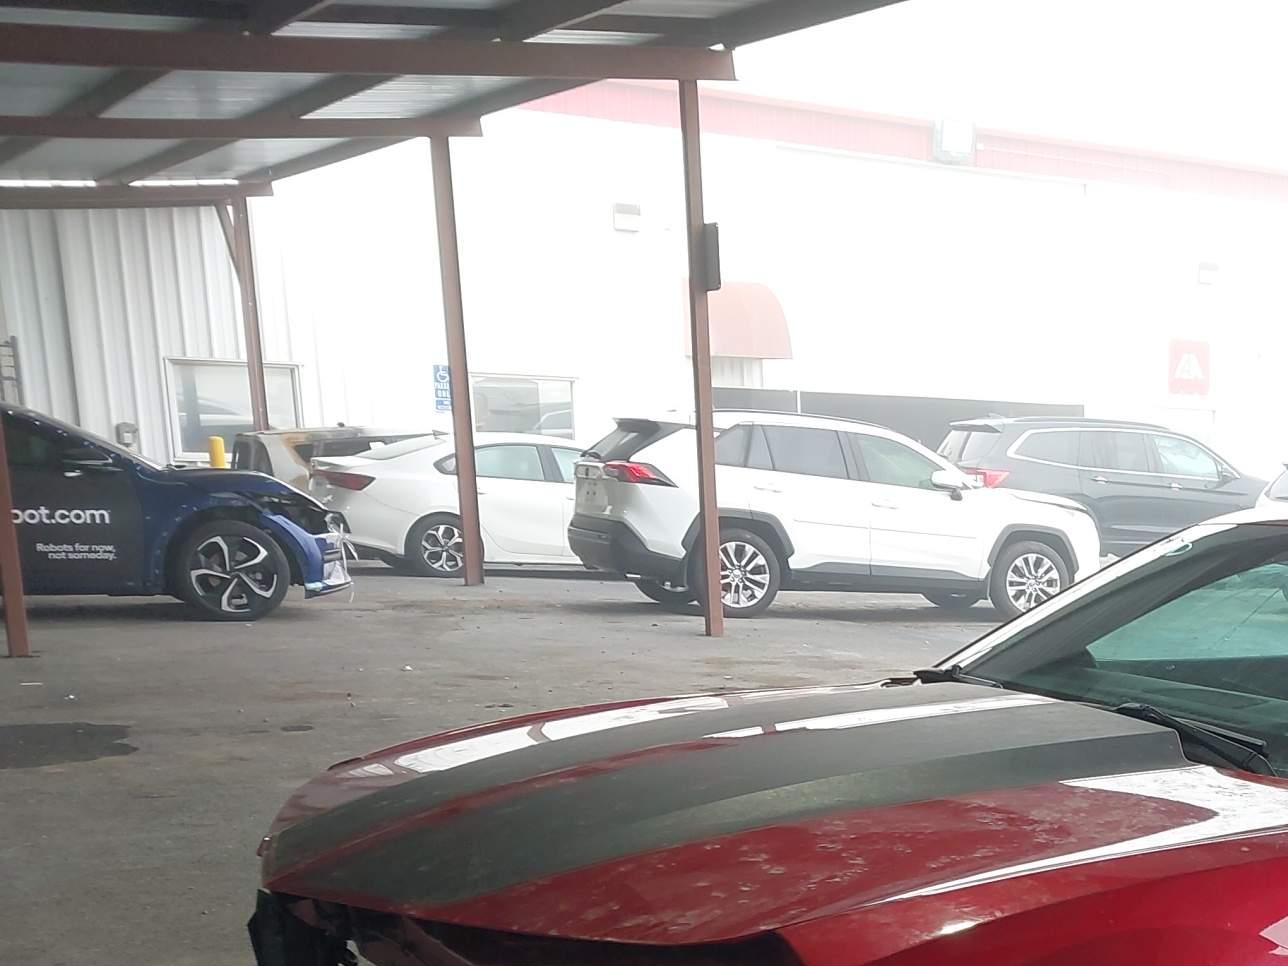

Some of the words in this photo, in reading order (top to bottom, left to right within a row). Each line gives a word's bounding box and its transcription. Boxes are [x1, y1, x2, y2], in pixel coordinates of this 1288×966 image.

[36, 542, 73, 552] Robots
[75, 542, 90, 552] for
[91, 544, 116, 553] now,
[48, 551, 66, 559] not
[68, 551, 117, 560] someday.
